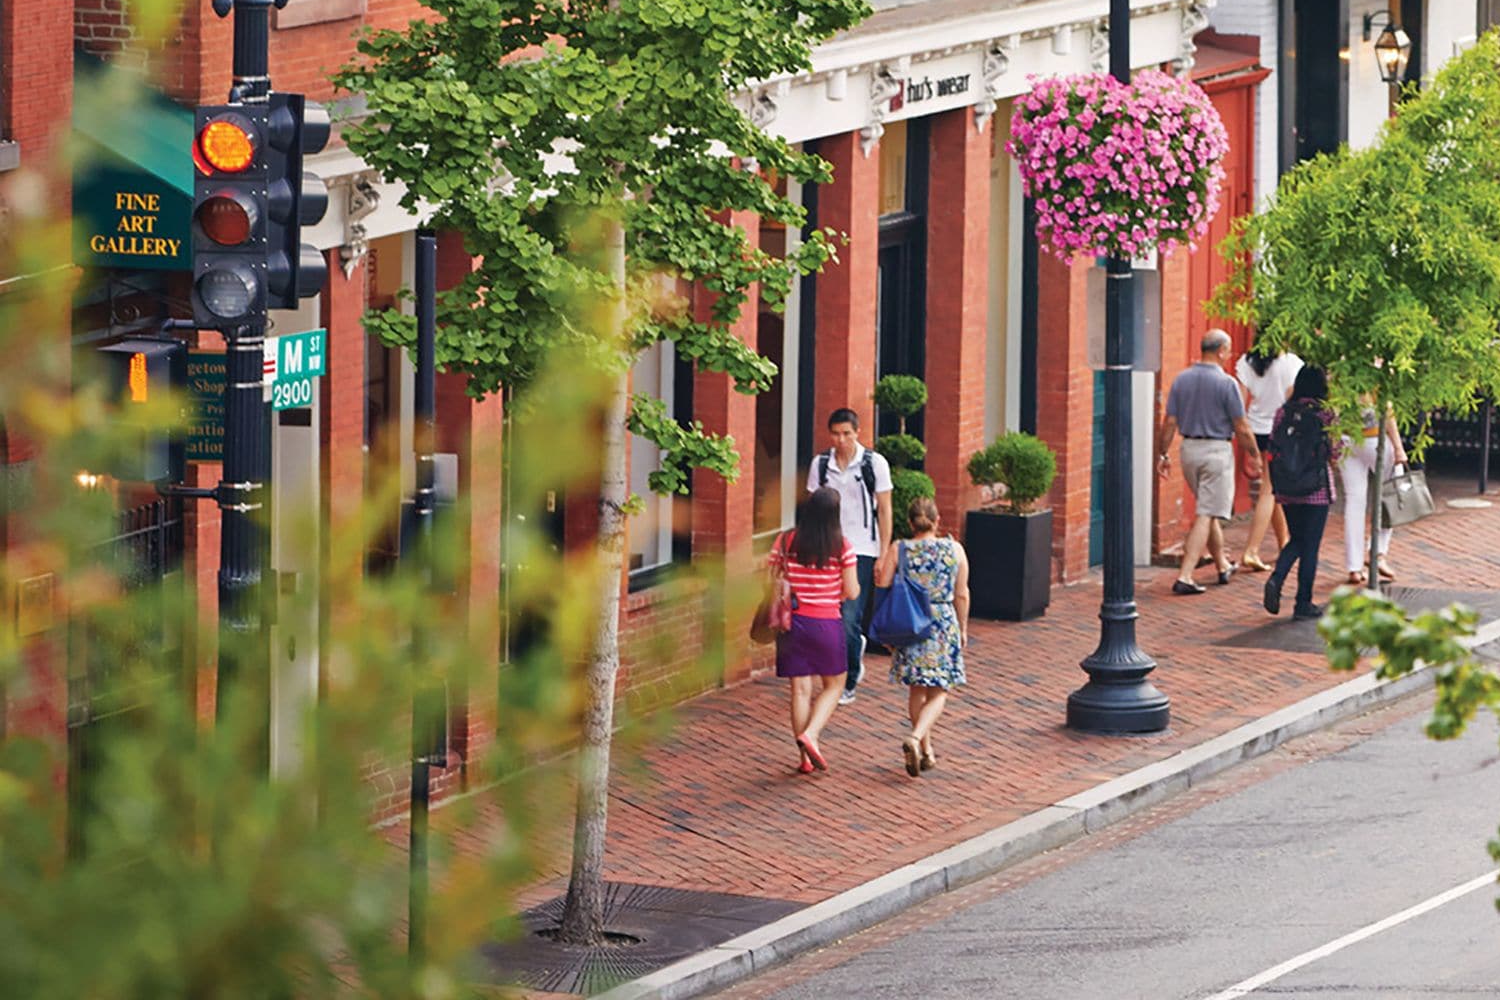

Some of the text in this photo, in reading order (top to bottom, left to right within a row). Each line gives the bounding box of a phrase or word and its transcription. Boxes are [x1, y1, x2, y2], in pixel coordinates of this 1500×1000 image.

[907, 73, 971, 103] hu's wear
[115, 191, 160, 212] FINE
[117, 215, 158, 233] ART
[90, 234, 181, 257] GALLERY
[284, 335, 320, 375] M ST
[273, 378, 311, 408] 2900
